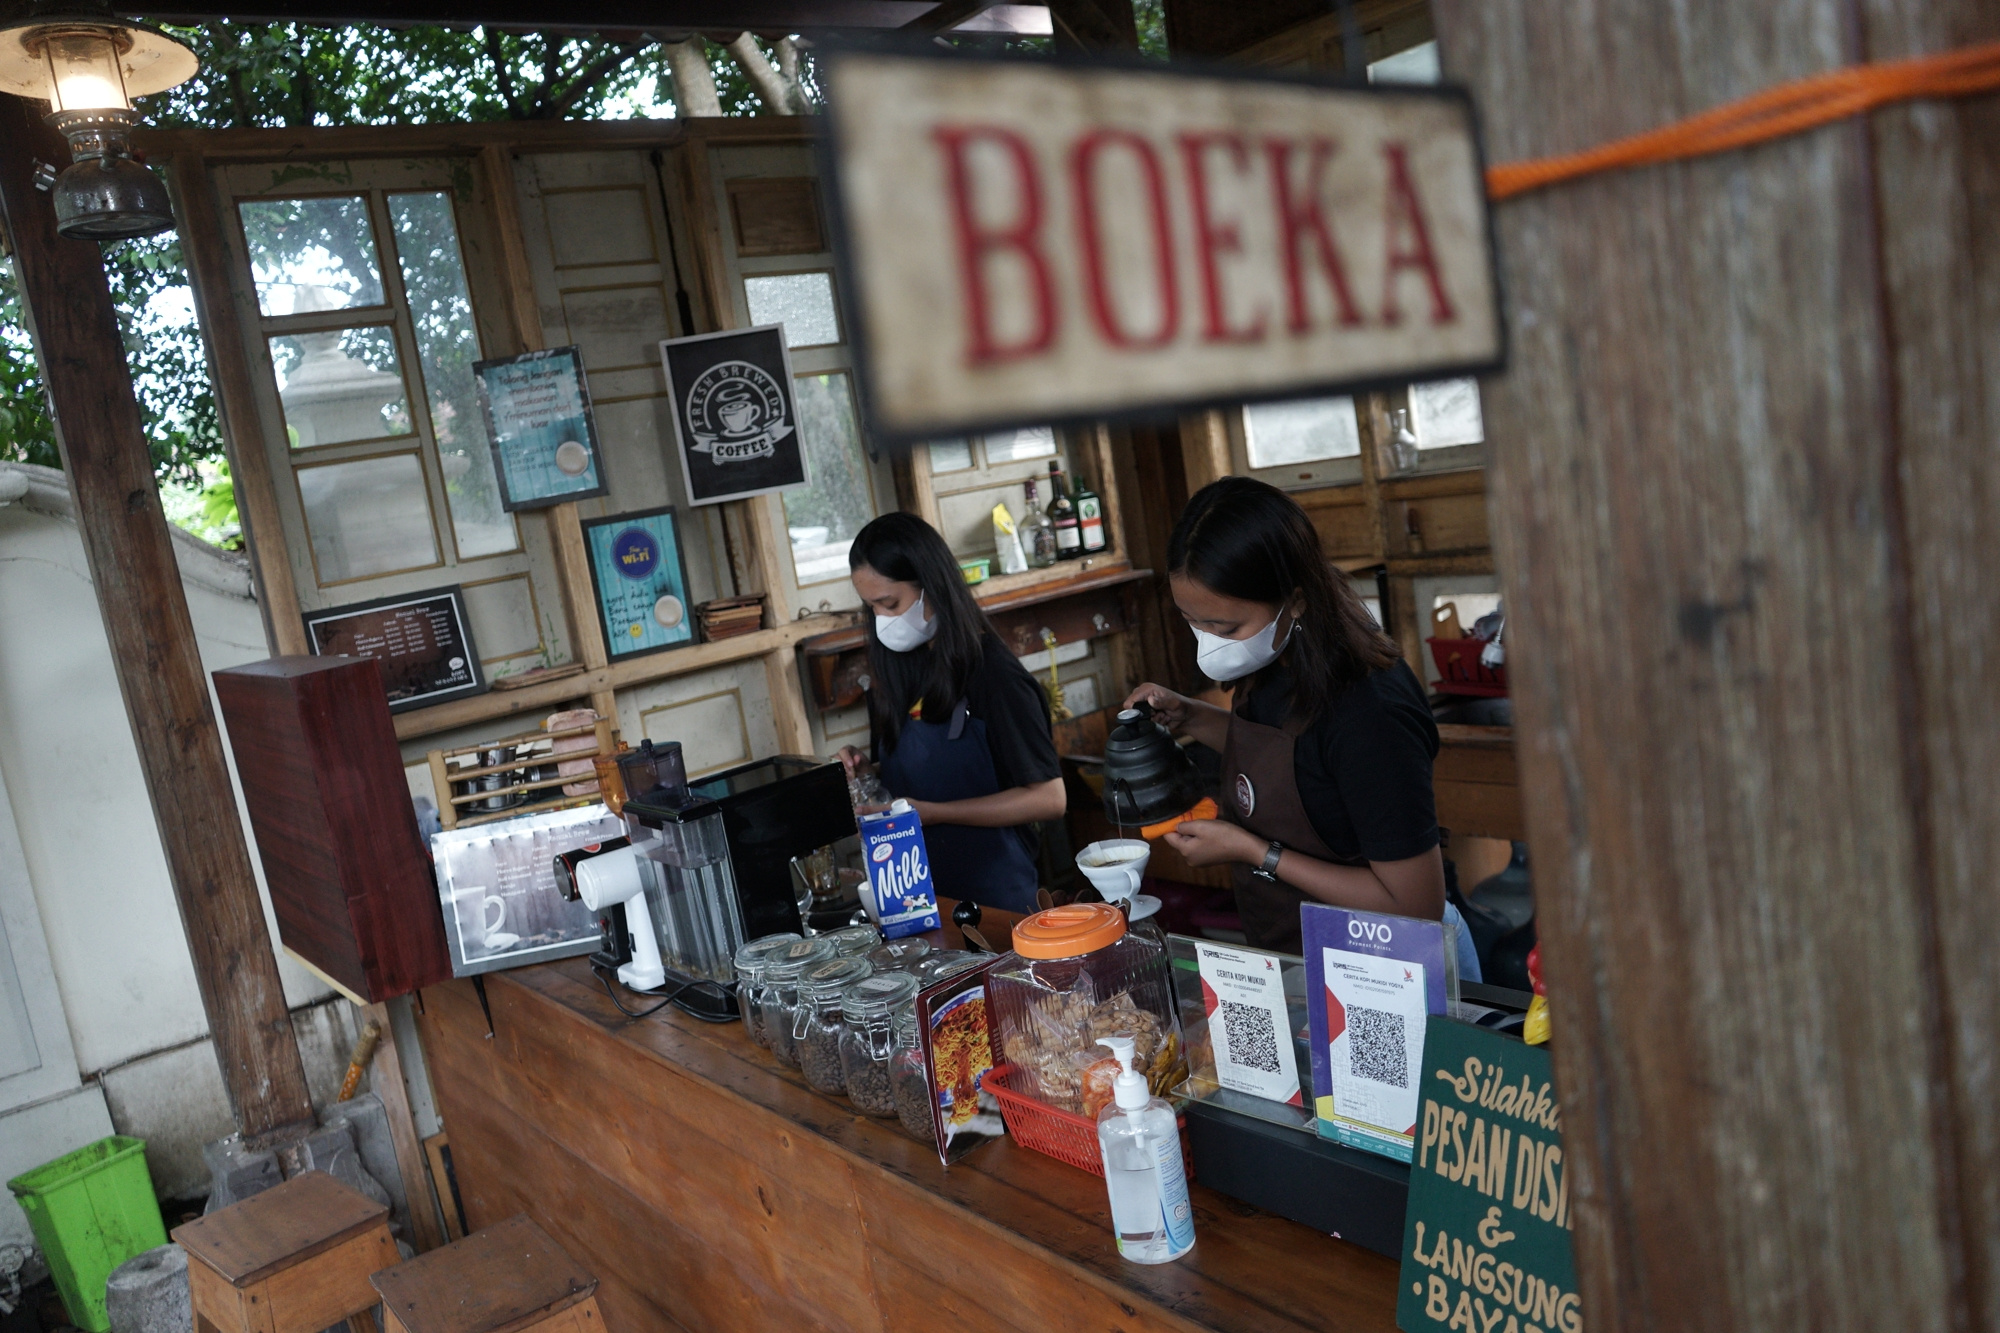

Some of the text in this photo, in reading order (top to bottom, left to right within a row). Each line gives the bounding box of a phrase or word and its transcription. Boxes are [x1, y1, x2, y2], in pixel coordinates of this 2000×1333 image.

[931, 120, 1458, 372] BOEKA
[691, 366, 779, 427] FRESH BREWED
[716, 438, 769, 456] COFFEE
[870, 826, 916, 845] Diamond
[878, 845, 928, 912] Milk
[1348, 919, 1392, 943] OVO
[1216, 969, 1267, 986] CERITA KOPI MUKIDI
[1388, 981, 1405, 990] YOGYA
[1419, 1099, 1511, 1201] PESAN
[1477, 1206, 1515, 1248] &
[1413, 1221, 1584, 1333] LANGSUNG
[1426, 1274, 1540, 1333] BAY
